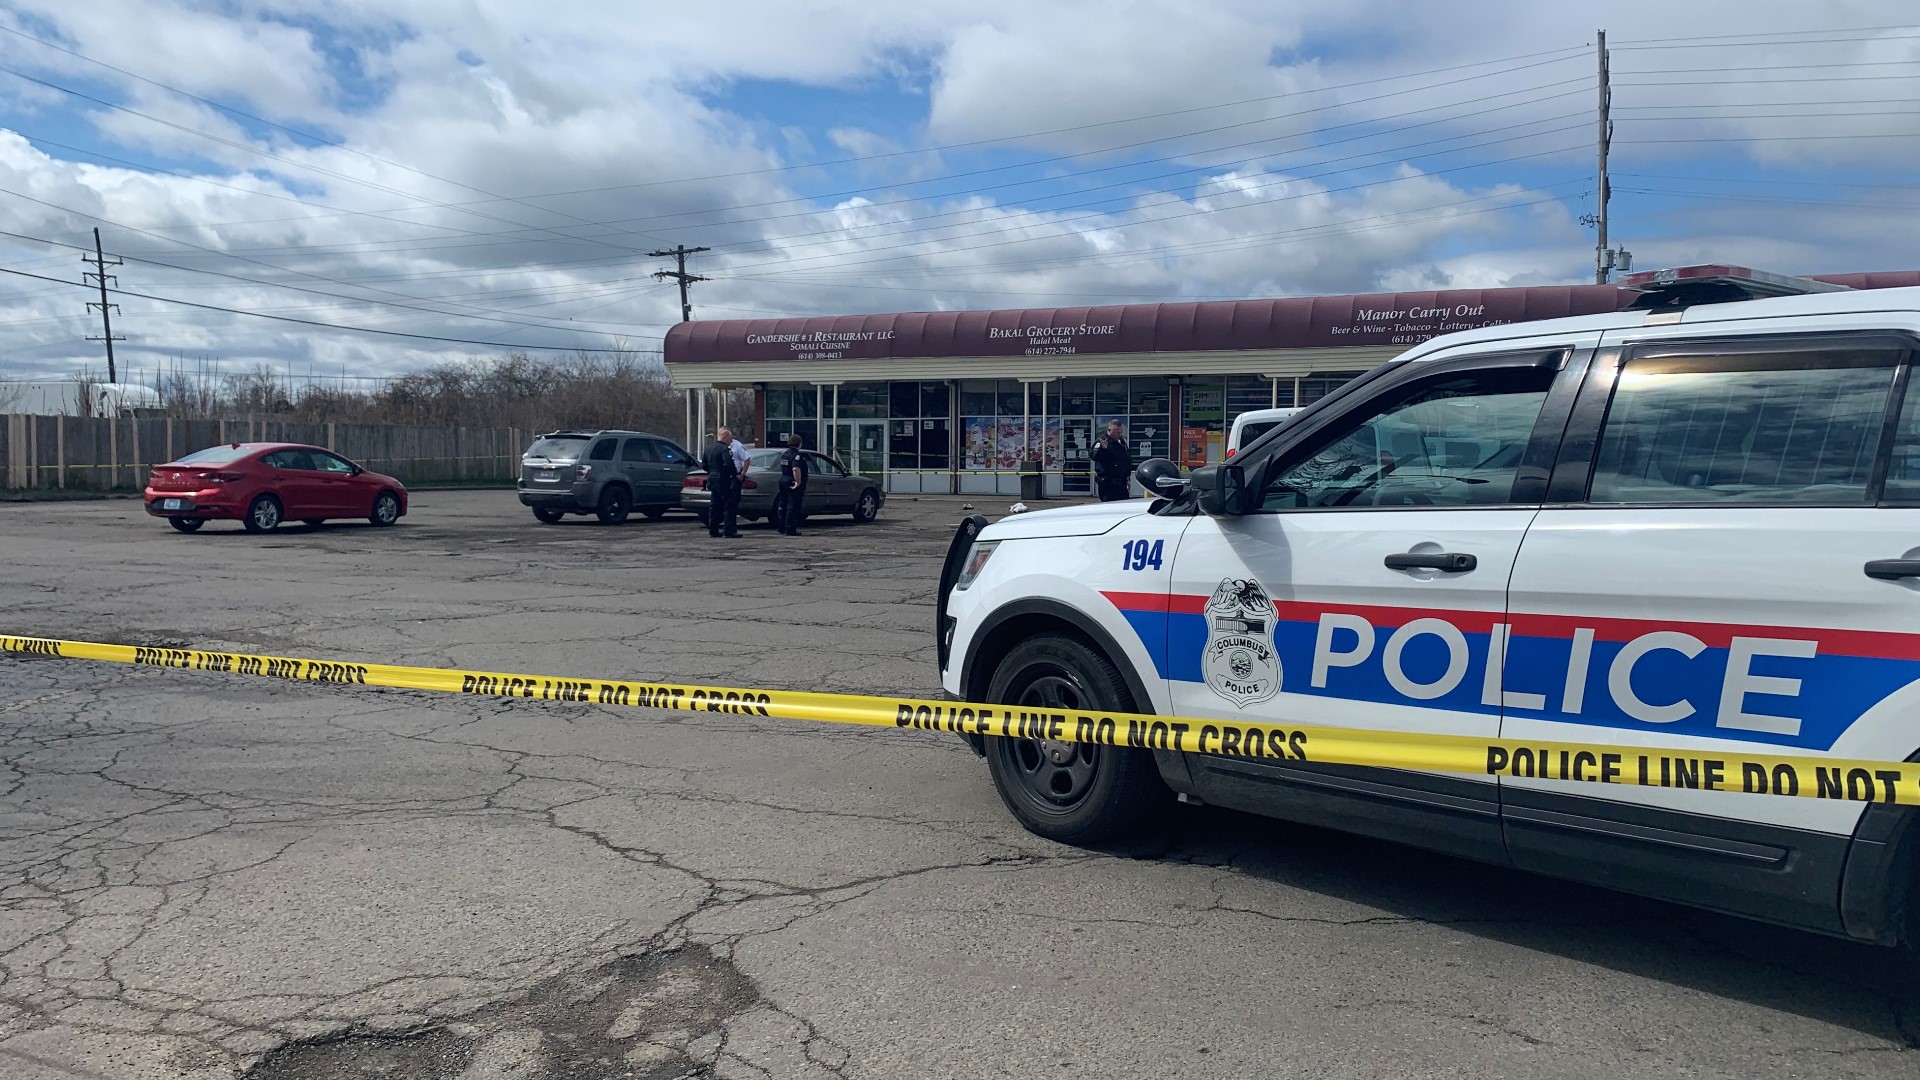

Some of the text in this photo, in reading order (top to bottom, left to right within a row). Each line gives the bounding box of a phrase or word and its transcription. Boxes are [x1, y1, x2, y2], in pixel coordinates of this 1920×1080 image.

[1357, 304, 1485, 322] Manor Carry Out
[990, 323, 1115, 338] BAKAL GROCERY STORE
[1331, 326, 1350, 334] Beer
[1352, 325, 1360, 334] &
[1363, 325, 1386, 333] Wine
[1394, 323, 1431, 332] Tobacco
[1440, 322, 1474, 331] Lottery
[746, 333, 800, 344] GANDERSHE
[814, 331, 874, 342] RESTAURANT
[1030, 336, 1071, 345] Halal Meat
[1391, 334, 1414, 343] (614)
[790, 341, 851, 351] SOMALI CUISINE
[1025, 347, 1043, 356] (614)
[1123, 539, 1164, 571] 194
[1217, 638, 1265, 654] COLUMBUS
[1310, 612, 1819, 737] POLICE
[1225, 680, 1260, 694] POLICE
[135, 647, 192, 667] POLICE
[198, 652, 234, 672] LINE
[237, 656, 262, 676] DO
[267, 658, 303, 679] NOT
[307, 661, 369, 684] CROSS
[461, 674, 537, 698] POLICE
[542, 680, 592, 702] LINE
[599, 684, 629, 706] DO
[638, 686, 684, 710] NOT
[690, 690, 770, 717] CROSS
[896, 704, 993, 735] POLICE
[1003, 711, 1066, 741] LINE
[1075, 716, 1115, 745] DO
[1127, 719, 1190, 751] NOT
[1199, 724, 1308, 761] CROSS
[1486, 745, 1621, 783] POLICE
[1638, 755, 1725, 790] LINE
[1742, 762, 1799, 797] DO
[1815, 766, 1901, 804] NOT
